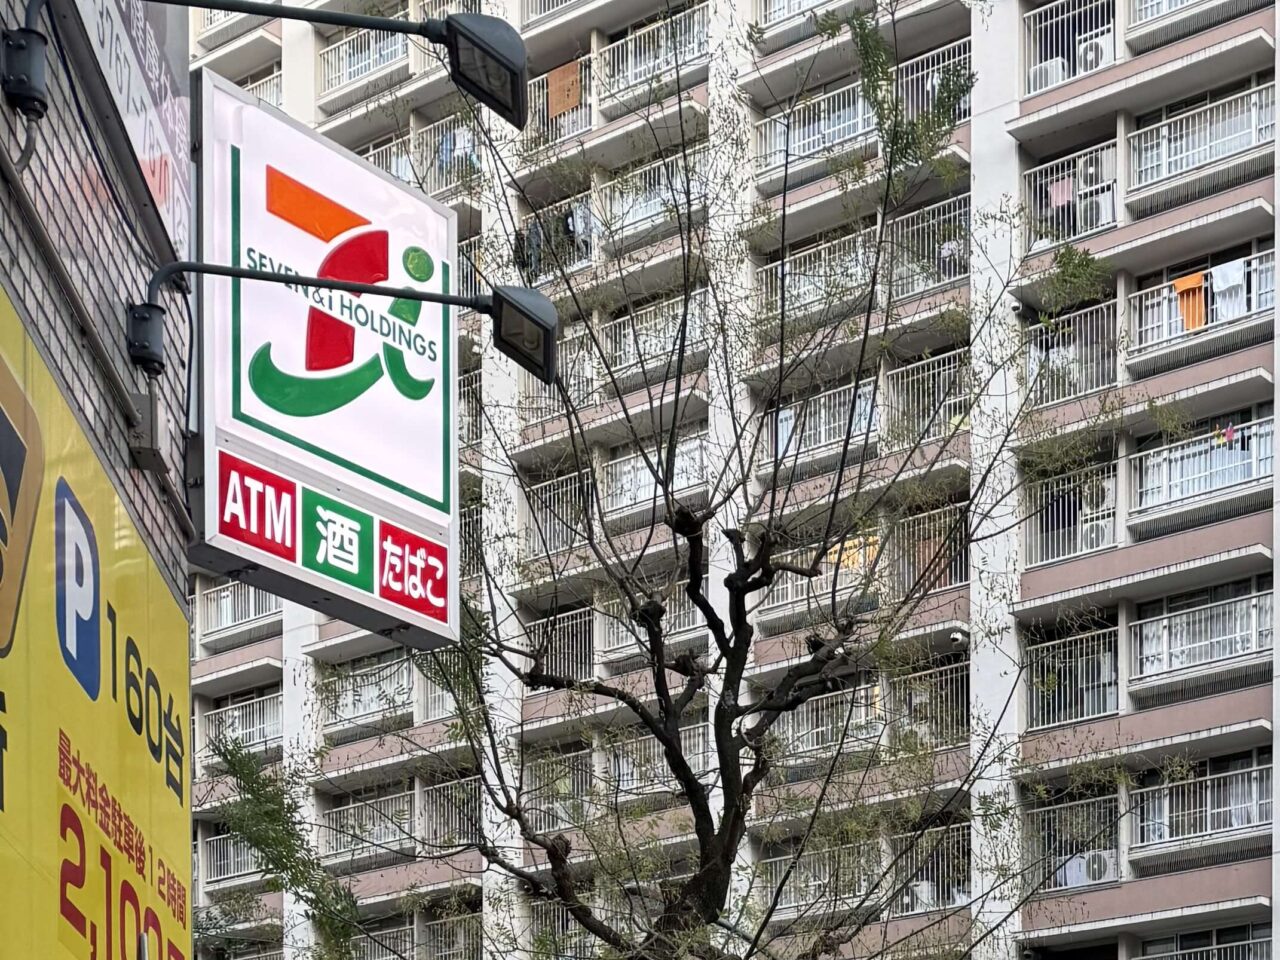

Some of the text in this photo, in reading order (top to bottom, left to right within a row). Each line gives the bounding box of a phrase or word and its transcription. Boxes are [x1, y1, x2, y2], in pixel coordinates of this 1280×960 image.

[340, 294, 437, 362] HOLDINGS
[223, 471, 293, 548] ATM
[316, 506, 360, 575] 酒
[64, 497, 94, 660] P
[381, 539, 447, 608] たばこ
[107, 599, 184, 808] 160台
